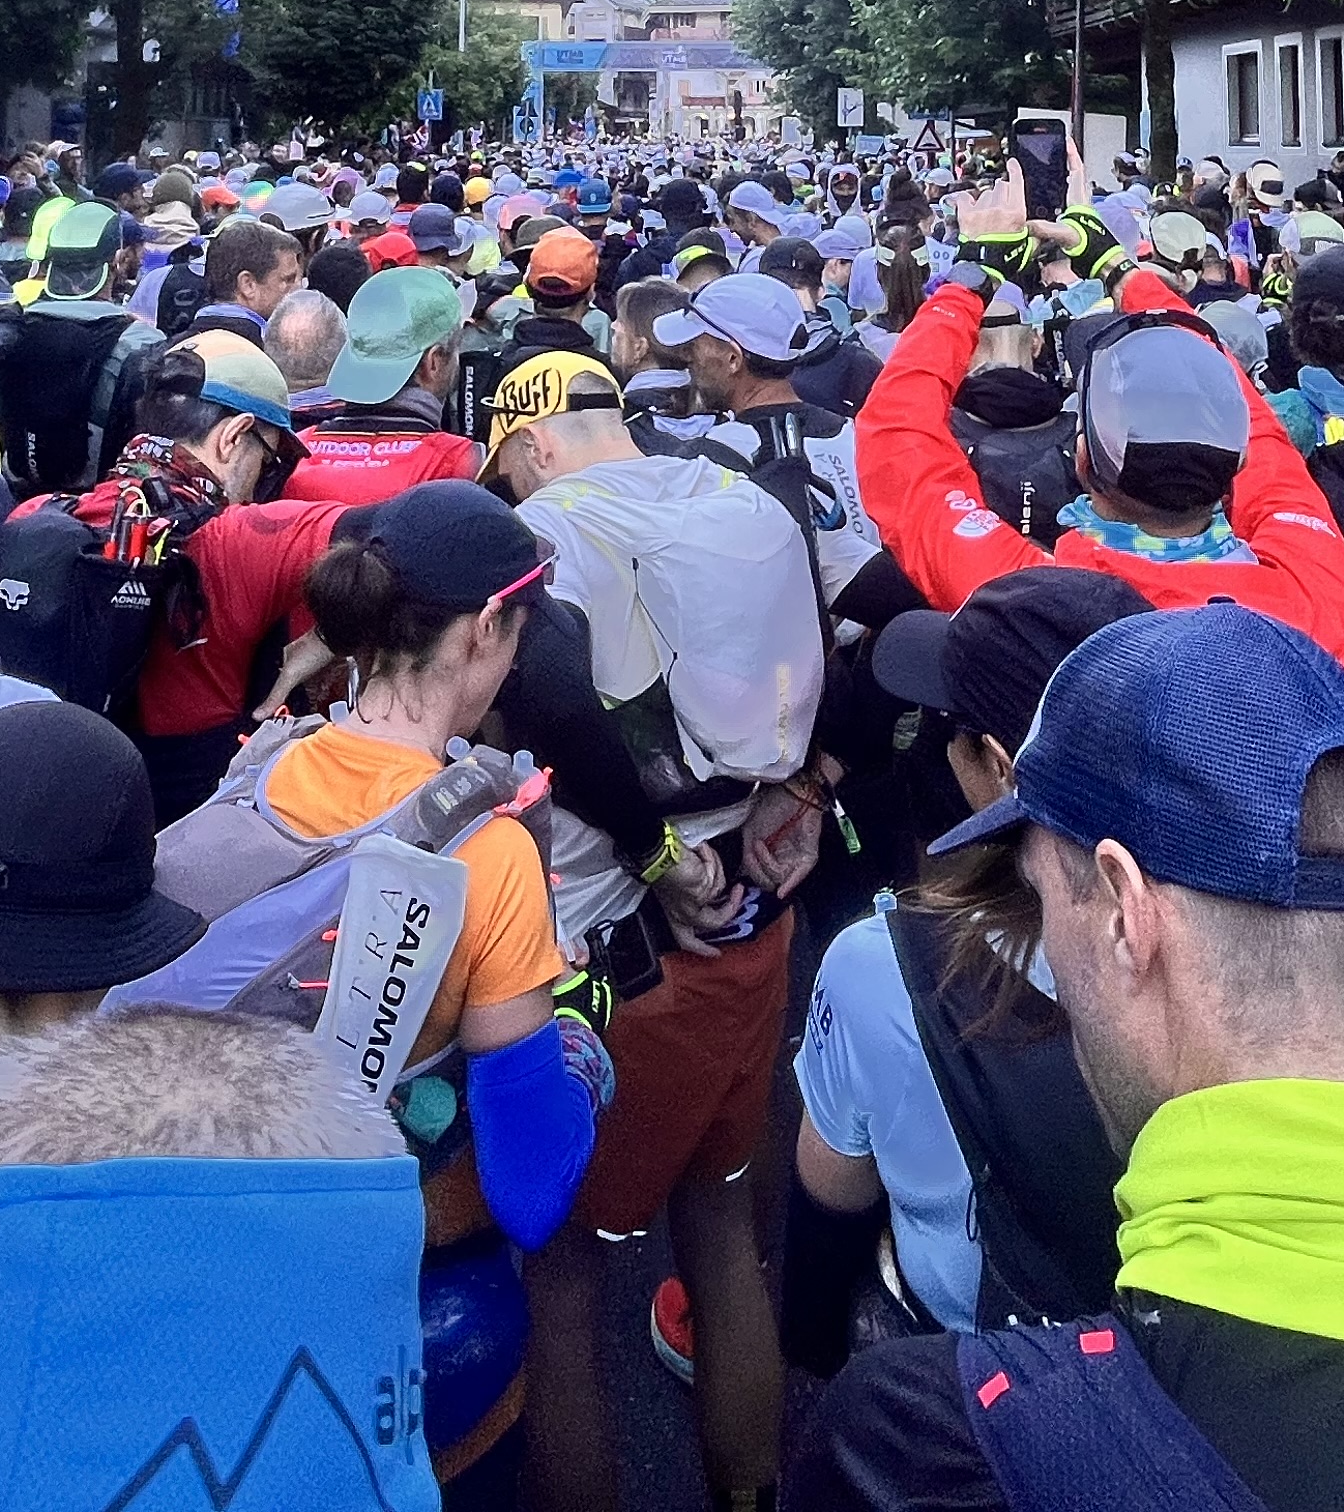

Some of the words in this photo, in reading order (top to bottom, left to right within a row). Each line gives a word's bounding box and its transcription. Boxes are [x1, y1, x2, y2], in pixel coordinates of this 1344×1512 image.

[309, 440, 372, 456] UTDOOR
[827, 454, 864, 535] SALOMO
[1020, 480, 1036, 535] alenji
